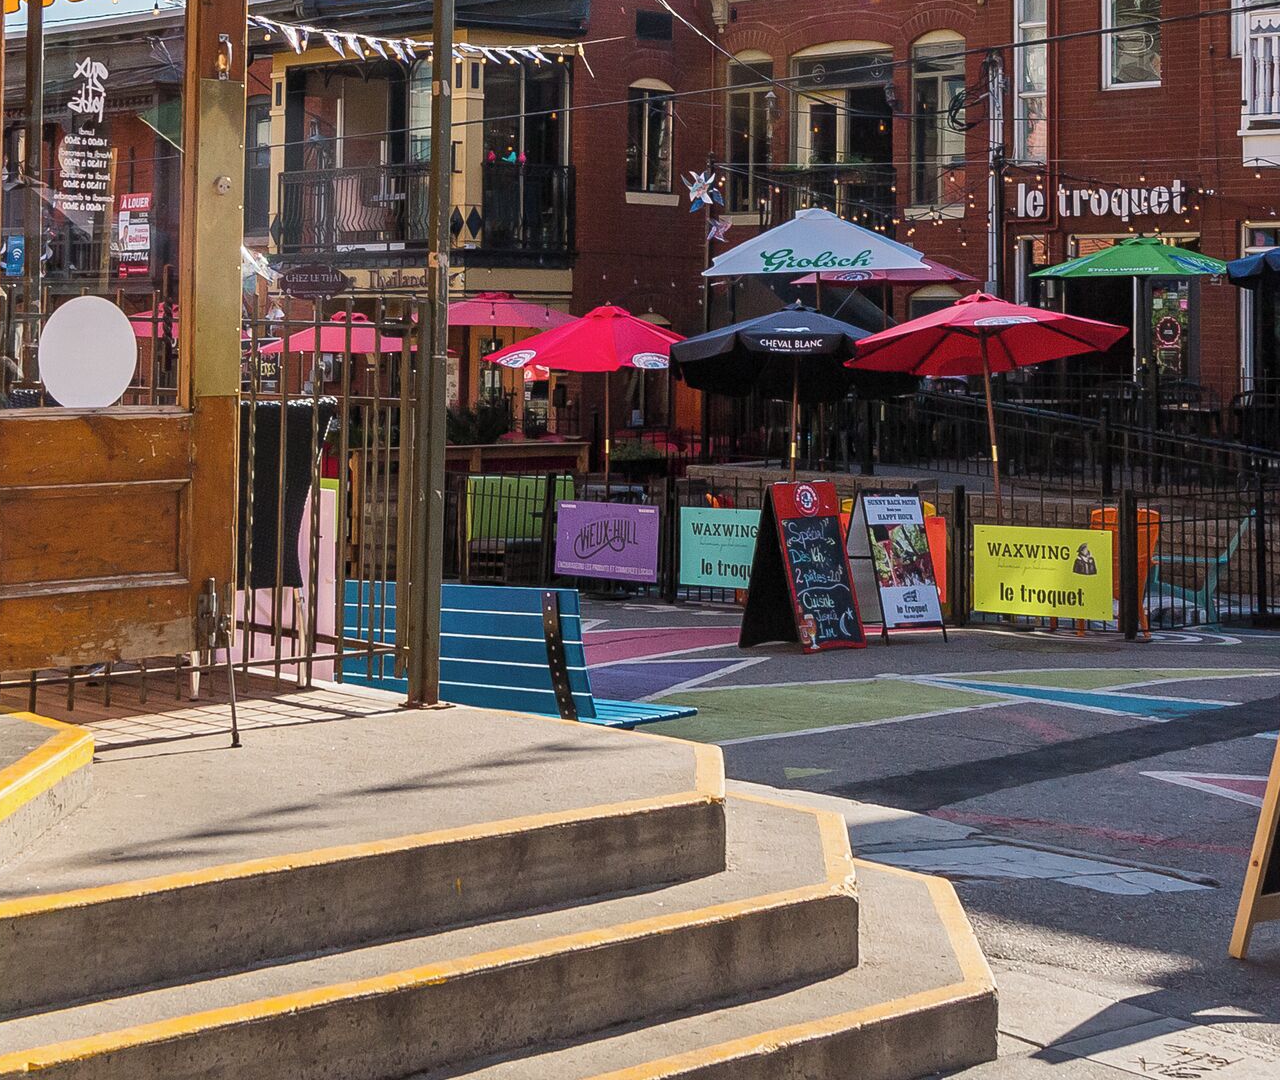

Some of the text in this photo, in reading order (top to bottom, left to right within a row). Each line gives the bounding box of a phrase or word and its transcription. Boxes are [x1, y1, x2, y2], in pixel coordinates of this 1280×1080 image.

[1017, 179, 1186, 222] le troquet
[760, 249, 873, 272] Grolsch
[286, 273, 309, 283] CHEZ
[310, 274, 319, 283] LE
[760, 338, 823, 348] CHEVAL BLANC
[691, 522, 758, 538] WAXWING
[986, 542, 1071, 561] WAXWING
[701, 558, 712, 576] le
[1000, 582, 1085, 608] le troquet
